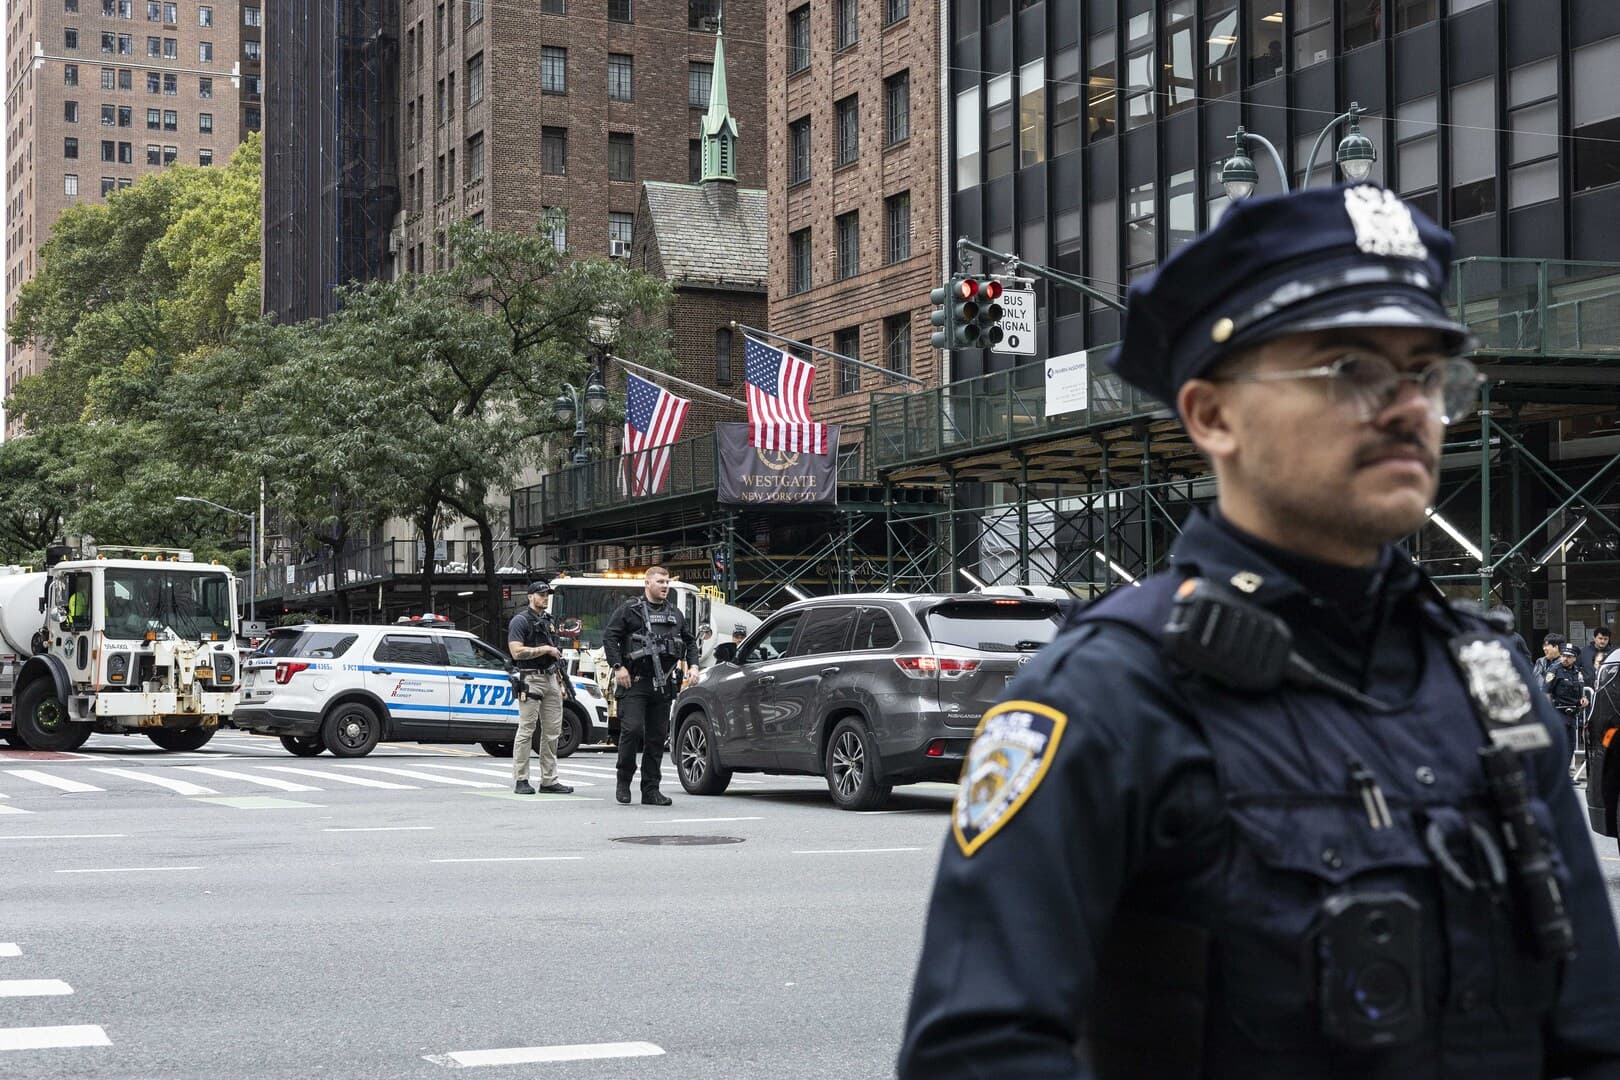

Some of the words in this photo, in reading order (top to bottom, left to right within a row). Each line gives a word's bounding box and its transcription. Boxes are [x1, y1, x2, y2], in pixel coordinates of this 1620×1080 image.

[1003, 295, 1023, 306] BUS
[1002, 308, 1026, 319] ONLY
[997, 320, 1031, 332] SIGNAL
[742, 475, 817, 487] WESTGATE
[741, 491, 764, 502] NEW
[765, 491, 793, 502] YORK
[794, 491, 817, 501] CITY
